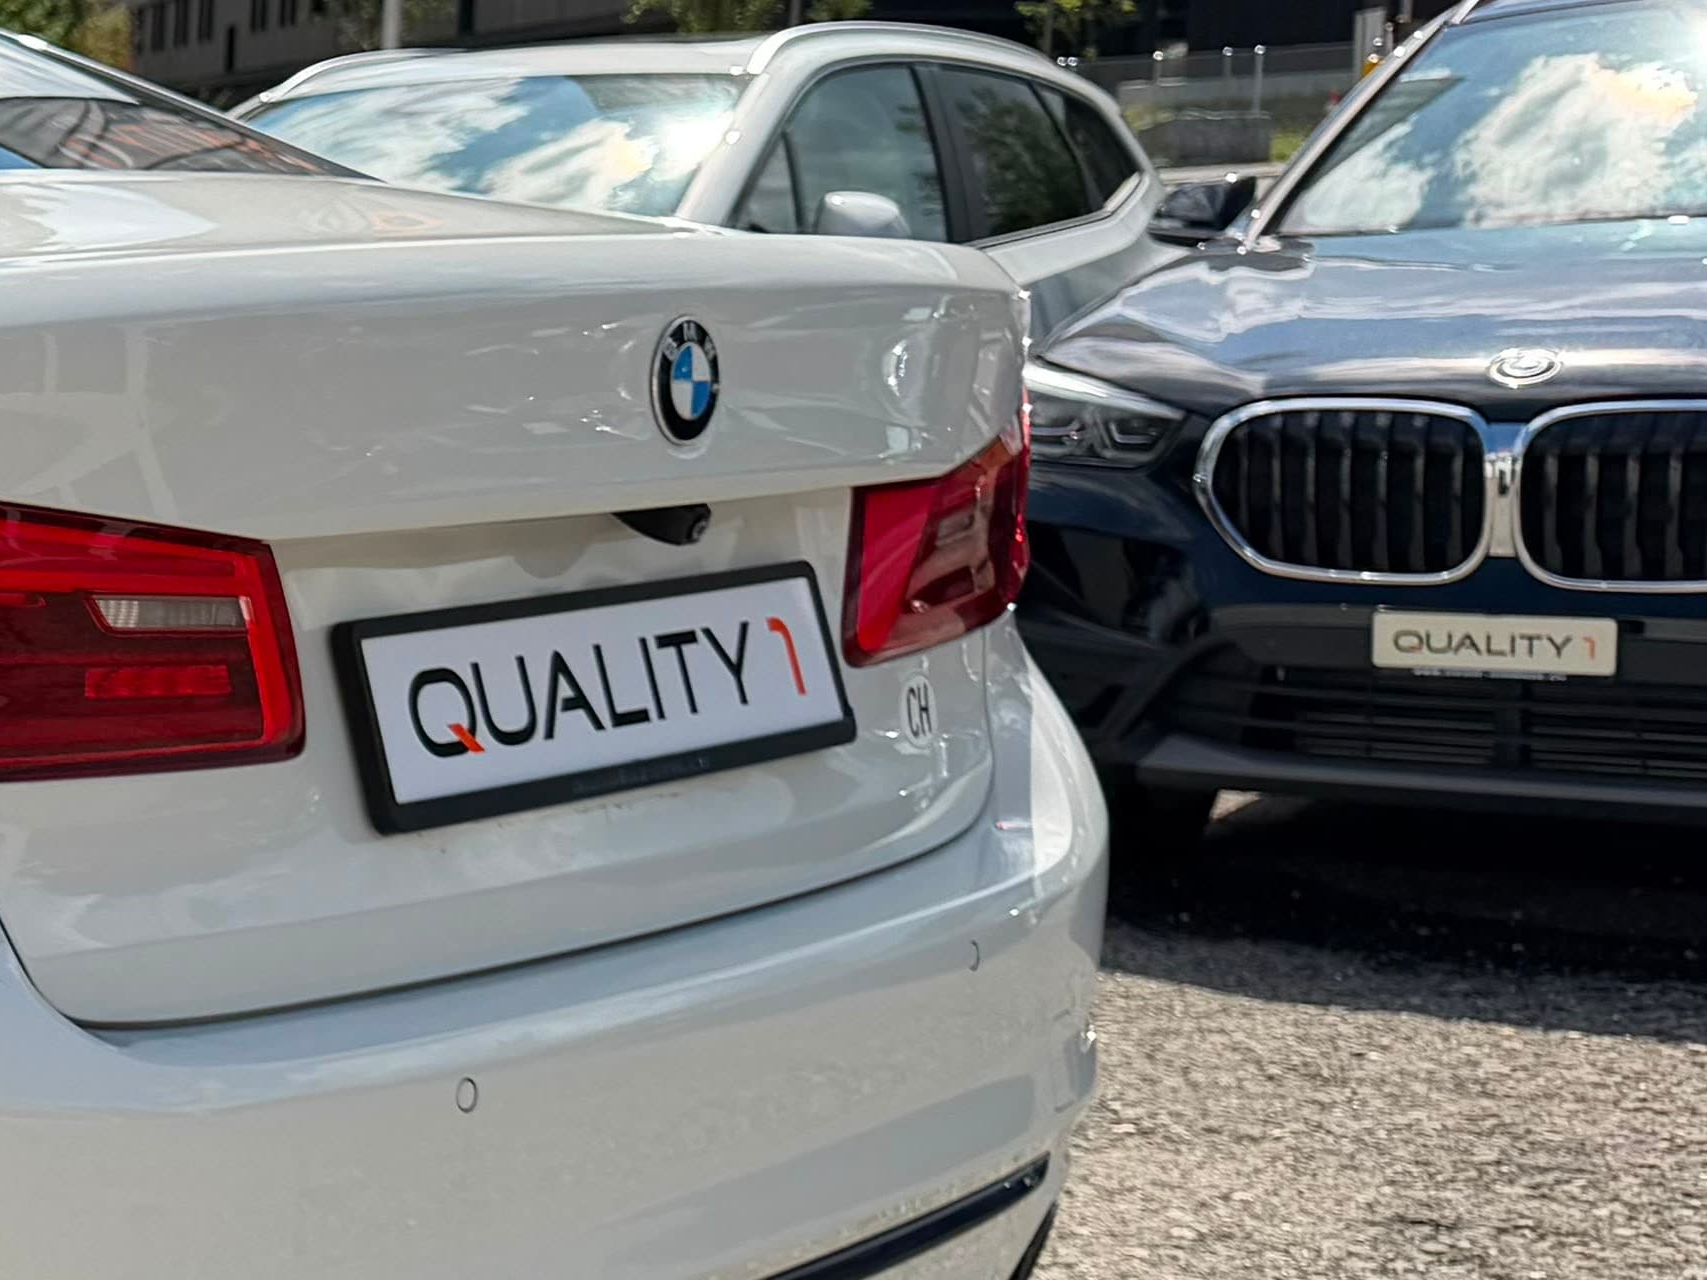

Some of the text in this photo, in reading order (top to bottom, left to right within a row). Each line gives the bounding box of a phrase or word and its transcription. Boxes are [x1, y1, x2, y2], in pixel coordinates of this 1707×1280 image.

[1393, 629, 1595, 660] QUALITY 1
[408, 617, 807, 758] QUALITY 1
[906, 683, 932, 738] CH
